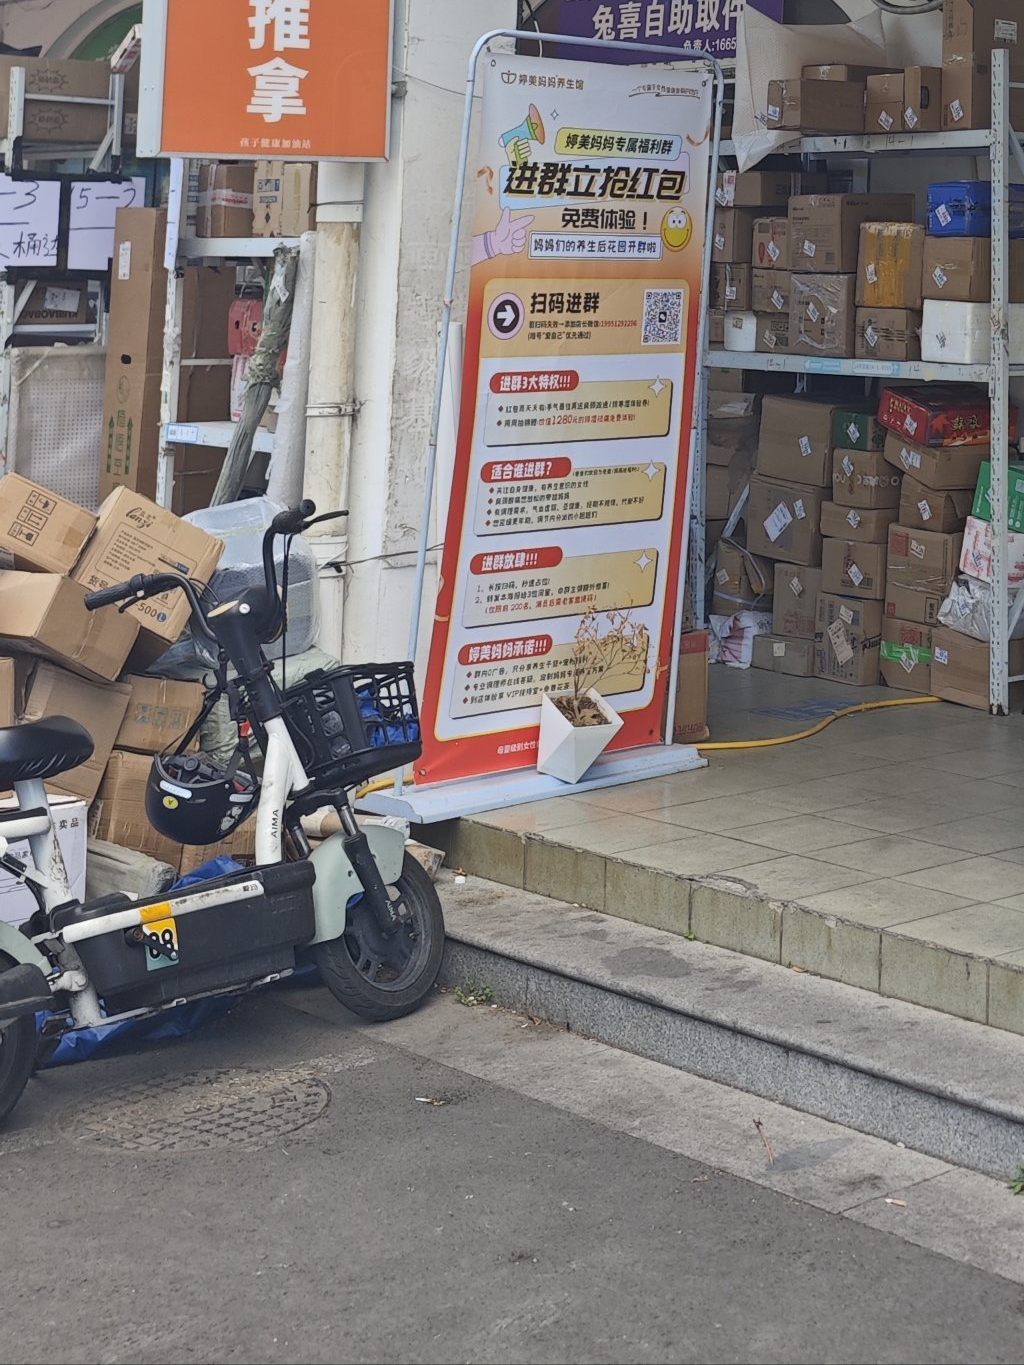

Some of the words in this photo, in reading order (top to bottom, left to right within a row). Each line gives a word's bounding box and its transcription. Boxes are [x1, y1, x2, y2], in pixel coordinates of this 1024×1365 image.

[517, 73, 584, 91] 婷美妈妈养生馆
[239, 136, 312, 150] 孩子健康加油站
[565, 133, 674, 155] 婷美妈妈专属福利群
[503, 161, 687, 202] 进群立抢红包
[533, 238, 657, 254] 妈妈们的养生后花园开群啦
[530, 292, 600, 315] 扫码进群
[491, 461, 552, 480] 适合谁进群?
[53, 816, 79, 831] 卖品
[270, 808, 280, 839] AIMA
[384, 899, 397, 922] AIMA
